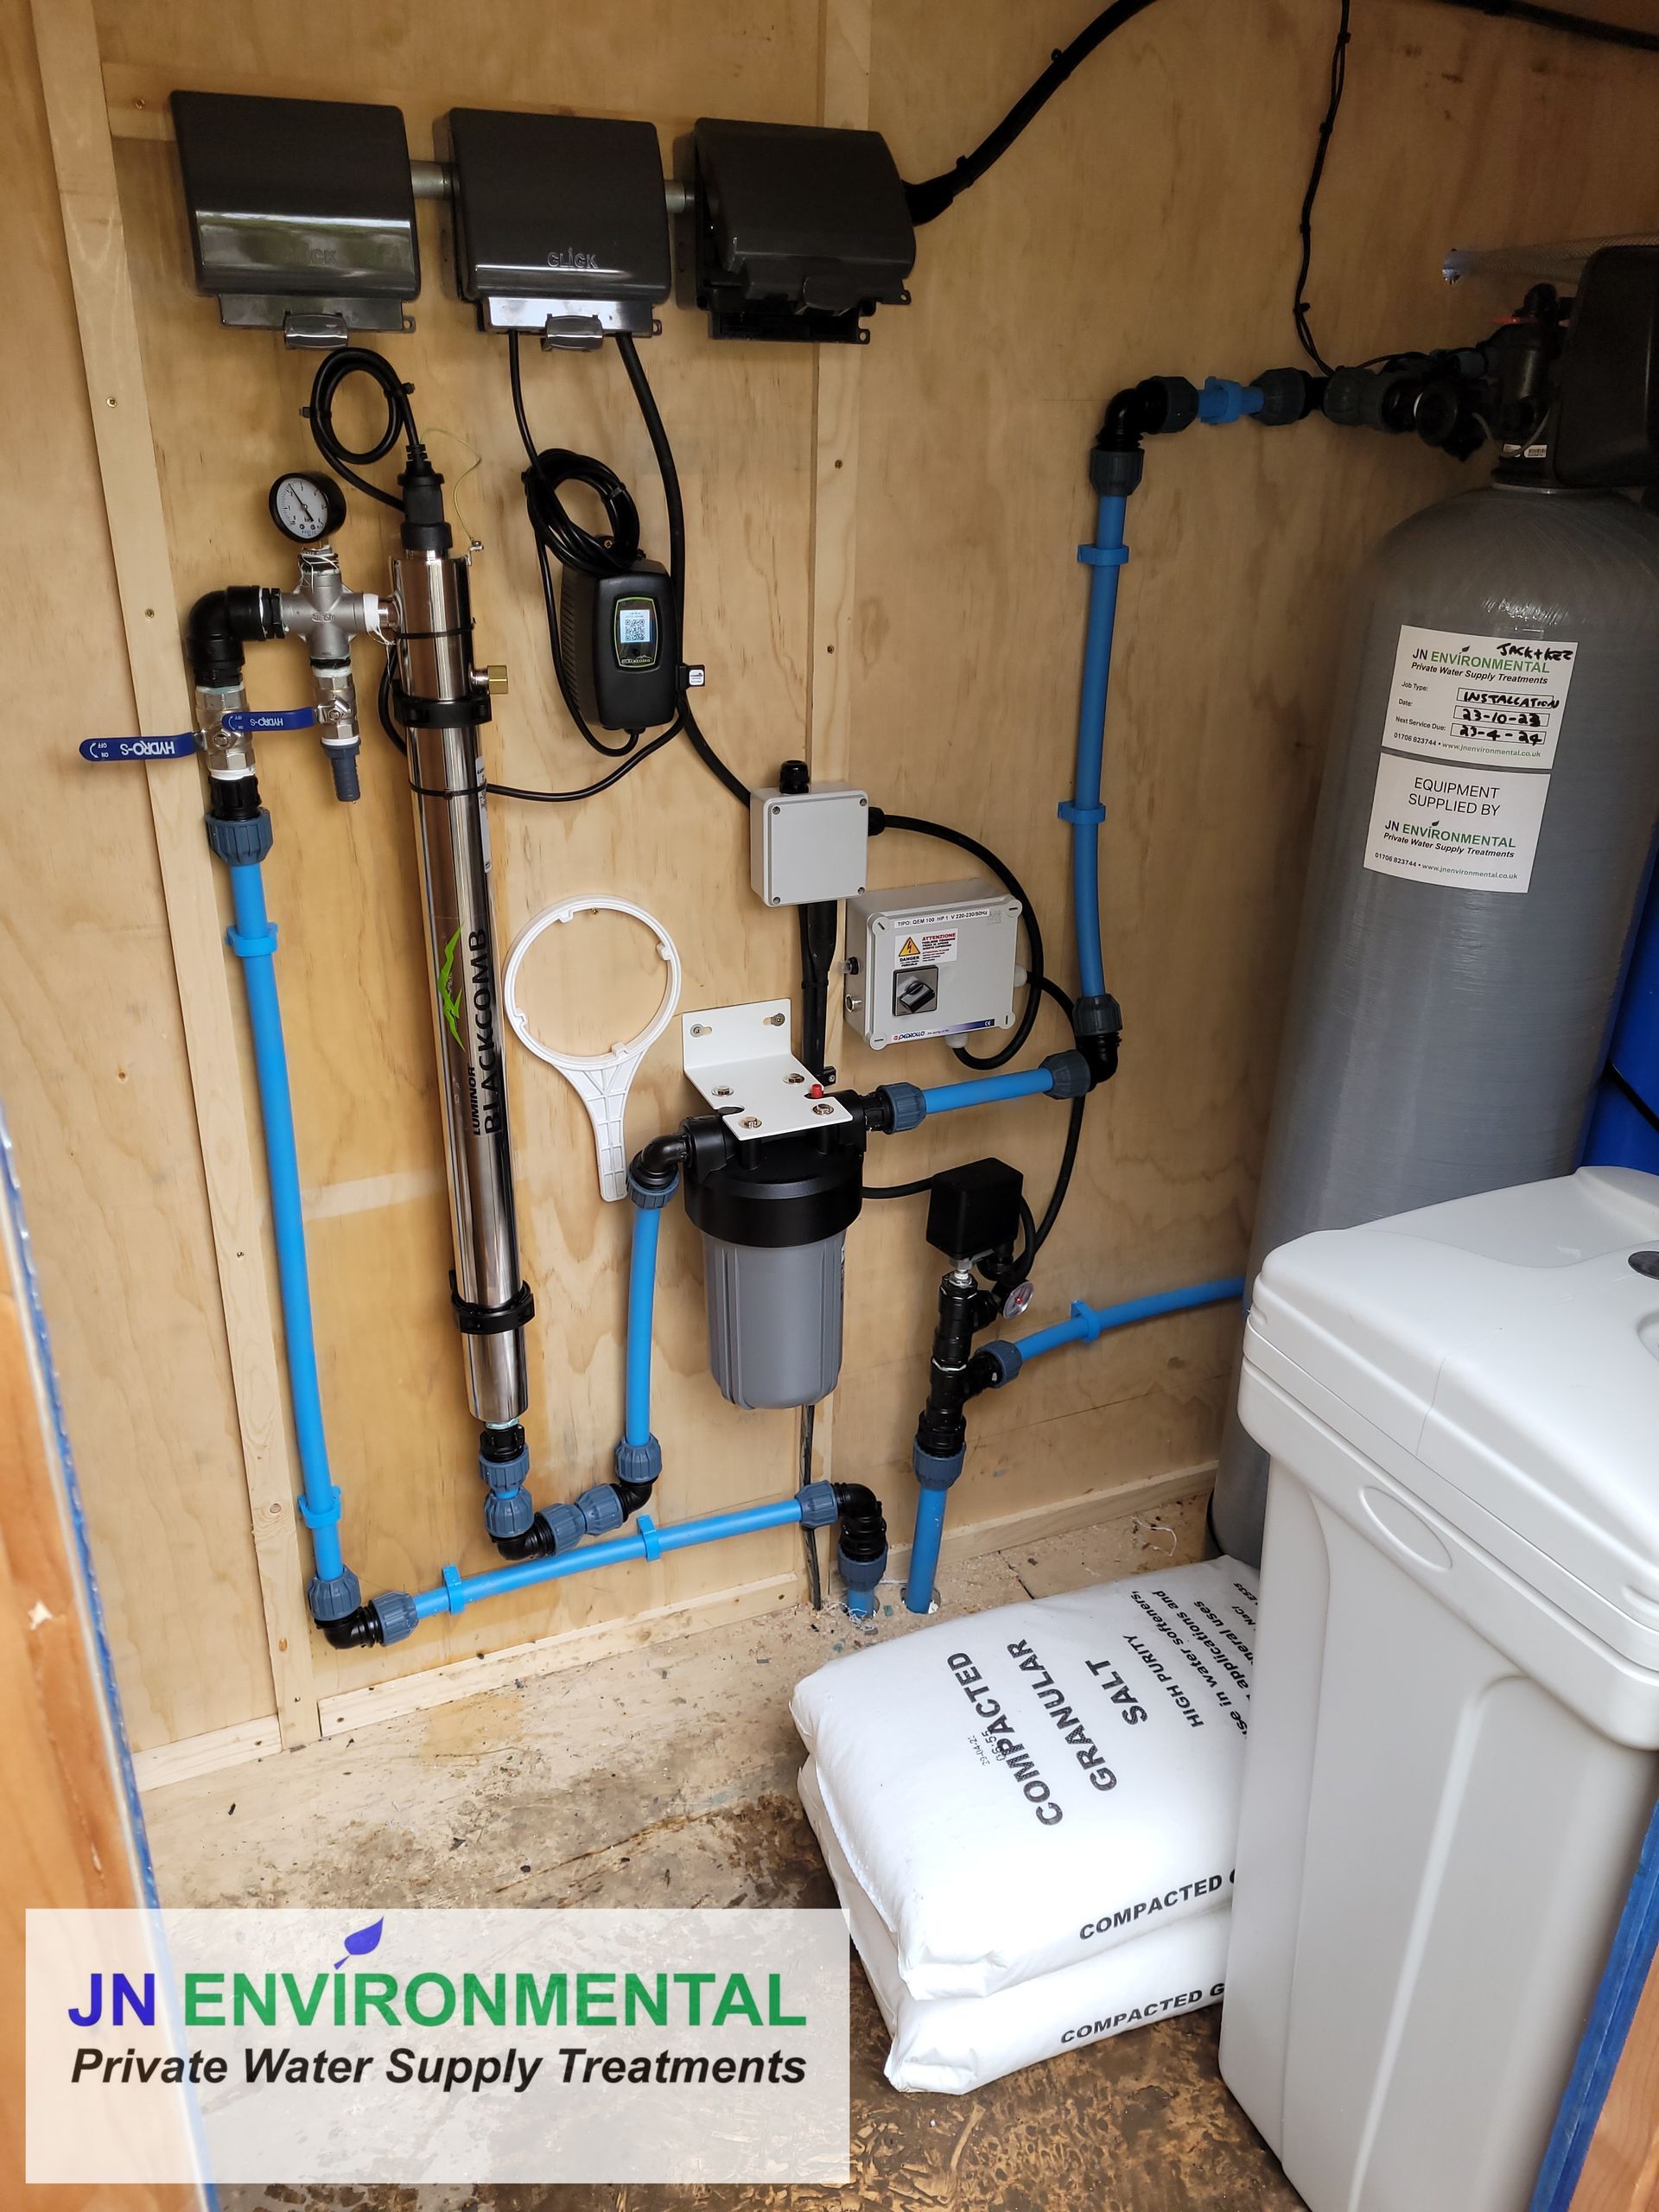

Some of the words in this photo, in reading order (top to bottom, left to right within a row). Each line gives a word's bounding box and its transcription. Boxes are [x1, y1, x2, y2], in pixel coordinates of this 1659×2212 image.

[547, 247, 599, 269] CLICK
[1411, 662, 1438, 674] Private
[1440, 667, 1463, 677] Water
[1465, 671, 1495, 682] Supply
[1497, 673, 1548, 684] Treatments
[1413, 648, 1428, 660] JN
[1431, 651, 1550, 673] ENVIRONMENTAL
[1398, 698, 1413, 707] Date:
[250, 717, 283, 726] HYDRO-S
[1408, 719, 1431, 729] Service
[1432, 722, 1446, 731] Due:
[120, 741, 175, 755] HYDRO-S
[1394, 733, 1413, 743] 01706
[1413, 735, 1436, 747] 823744
[1442, 741, 1541, 758] www.jnenvironmental.co.uk
[1414, 778, 1500, 799] EQUIPMENT
[1408, 793, 1478, 814] SUPPLIED
[1480, 804, 1501, 817] BY
[1383, 833, 1409, 845] Private
[1410, 838, 1433, 849] Water
[1435, 842, 1465, 855] Supply
[1467, 848, 1515, 858] Treatments
[1384, 820, 1400, 832] JN
[1402, 823, 1516, 848] ENVIRONMENTAL
[1375, 852, 1393, 862] 01706
[1393, 857, 1417, 868] 823744
[1422, 864, 1518, 880] www.jnenvironmental.co.uk
[468, 928, 501, 1135] BLACKCOMB
[467, 1066, 480, 1135] LUMINOR
[1152, 1591, 1179, 1610] and
[1194, 1600, 1224, 1627] uses
[1130, 1591, 1184, 1646] softeners,
[1122, 1635, 1173, 1682] PURITY
[1177, 1611, 1249, 1689] applications
[1219, 1630, 1253, 1665] neral
[1180, 1649, 1217, 1688] water
[1085, 1660, 1148, 1726] SALT
[1166, 1685, 1205, 1728] HIGH
[1216, 1691, 1232, 1707] in
[1007, 1638, 1117, 1791] GRANULAR
[947, 1652, 1063, 1826] COMPACTED
[1080, 1874, 1222, 1940] COMPACTED
[1061, 1989, 1203, 2044] COMPACTED
